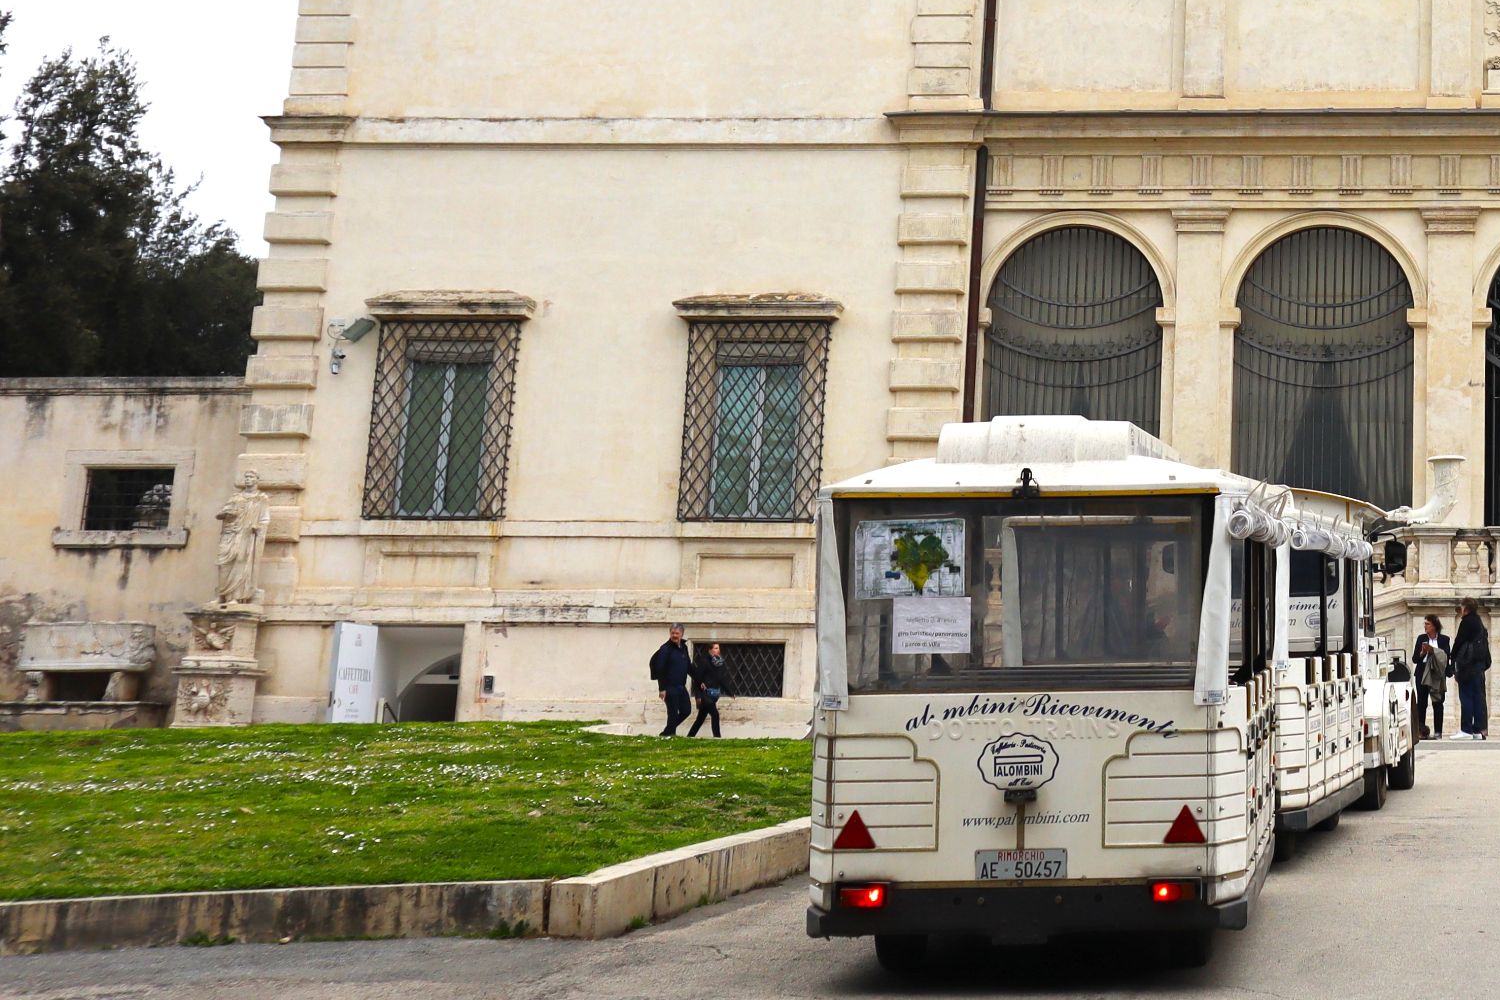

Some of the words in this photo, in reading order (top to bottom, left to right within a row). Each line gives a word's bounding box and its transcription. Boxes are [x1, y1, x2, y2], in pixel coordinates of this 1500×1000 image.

[1022, 693, 1178, 739] Ricevimenti
[927, 717, 1018, 741] DOTTO
[1027, 717, 1121, 740] TRAINS
[993, 754, 1044, 778] PALOMBINI
[962, 810, 1090, 829] www.palmbini.com
[997, 850, 1045, 861] RIMORCHIO
[980, 861, 999, 879] AE
[1014, 860, 1062, 878] 50457
